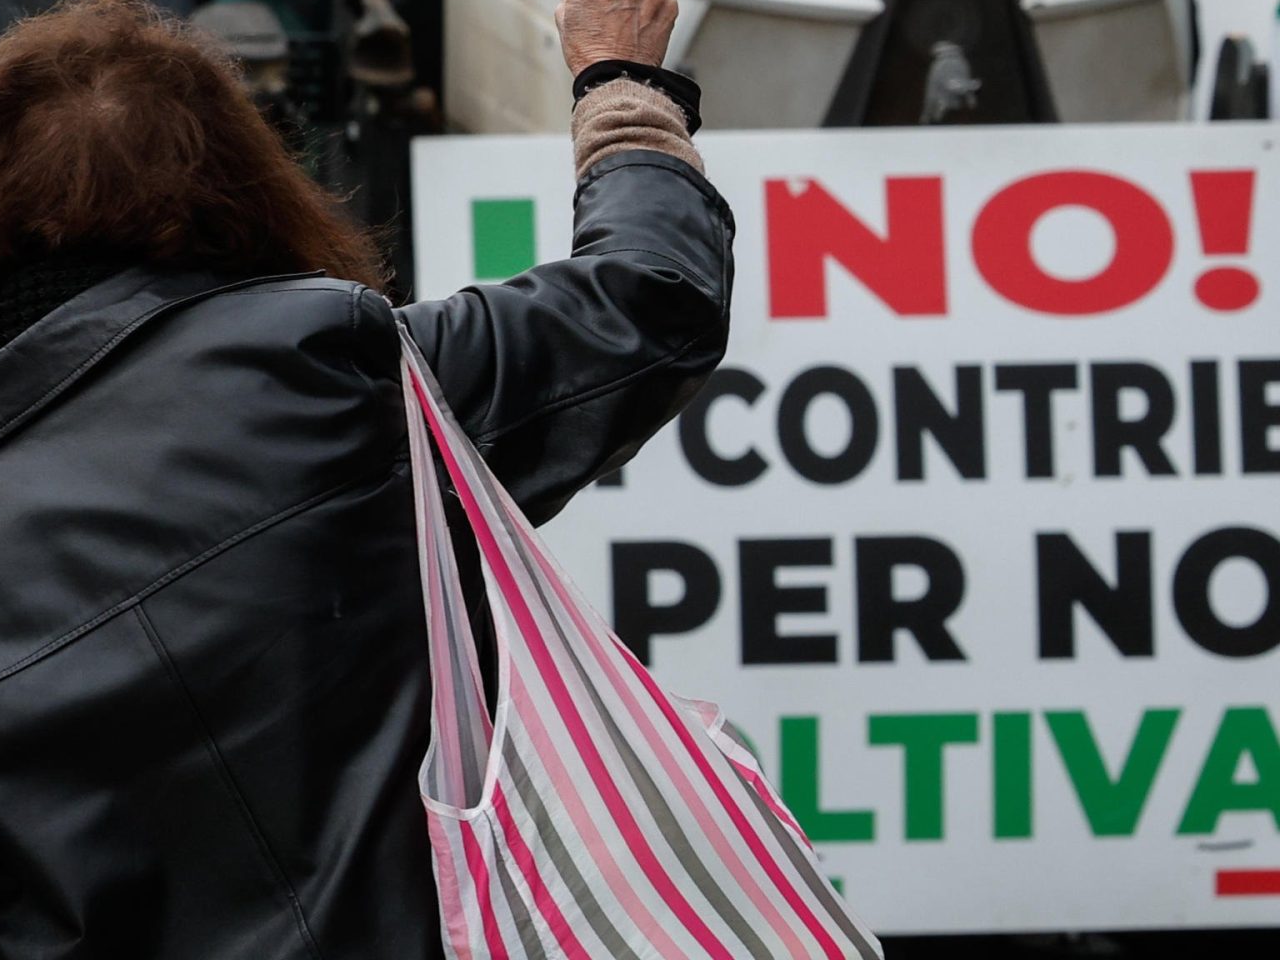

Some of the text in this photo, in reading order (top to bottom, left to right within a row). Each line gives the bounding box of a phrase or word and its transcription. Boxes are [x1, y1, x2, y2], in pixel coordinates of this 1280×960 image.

[765, 169, 1260, 319] NO!
[609, 525, 1280, 669] PER NO
[730, 705, 1280, 842] LTIVA
